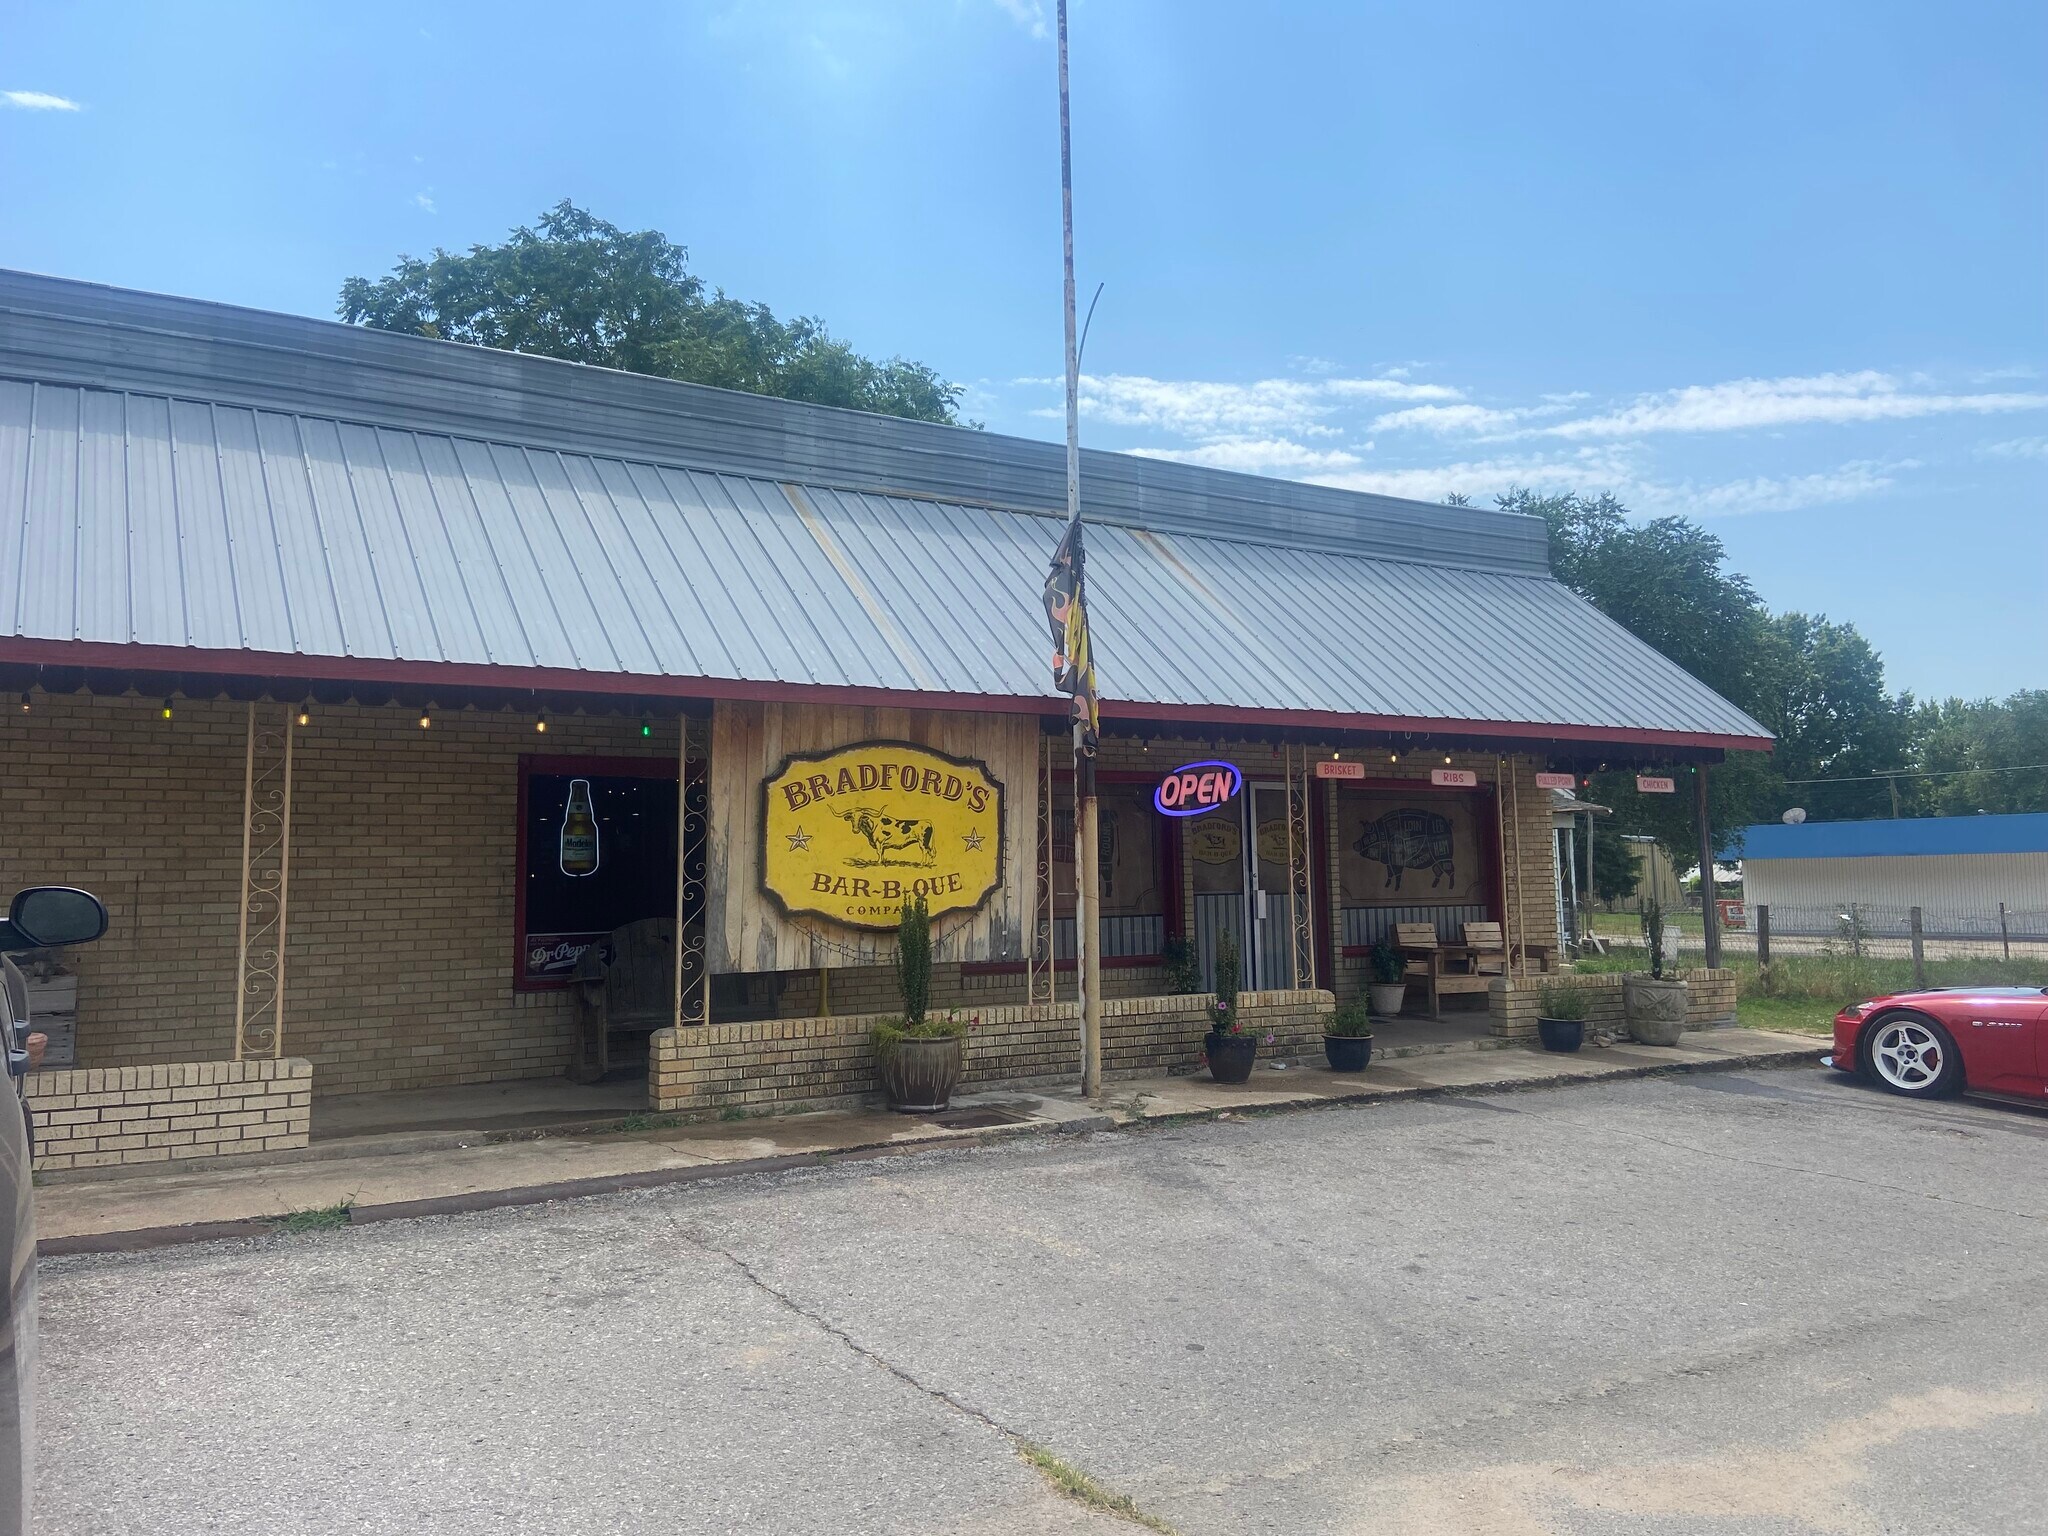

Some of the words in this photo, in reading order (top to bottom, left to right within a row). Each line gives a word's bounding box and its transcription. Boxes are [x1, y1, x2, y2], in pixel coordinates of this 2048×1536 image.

[1324, 764, 1357, 776] BRISKET
[1443, 772, 1464, 783] RIBS
[1642, 778, 1669, 789] CHICKEN
[781, 763, 990, 814] BRADFORD'S
[1160, 771, 1233, 807] OPEN
[846, 905, 901, 916] COMPA
[530, 946, 554, 965] Dr
